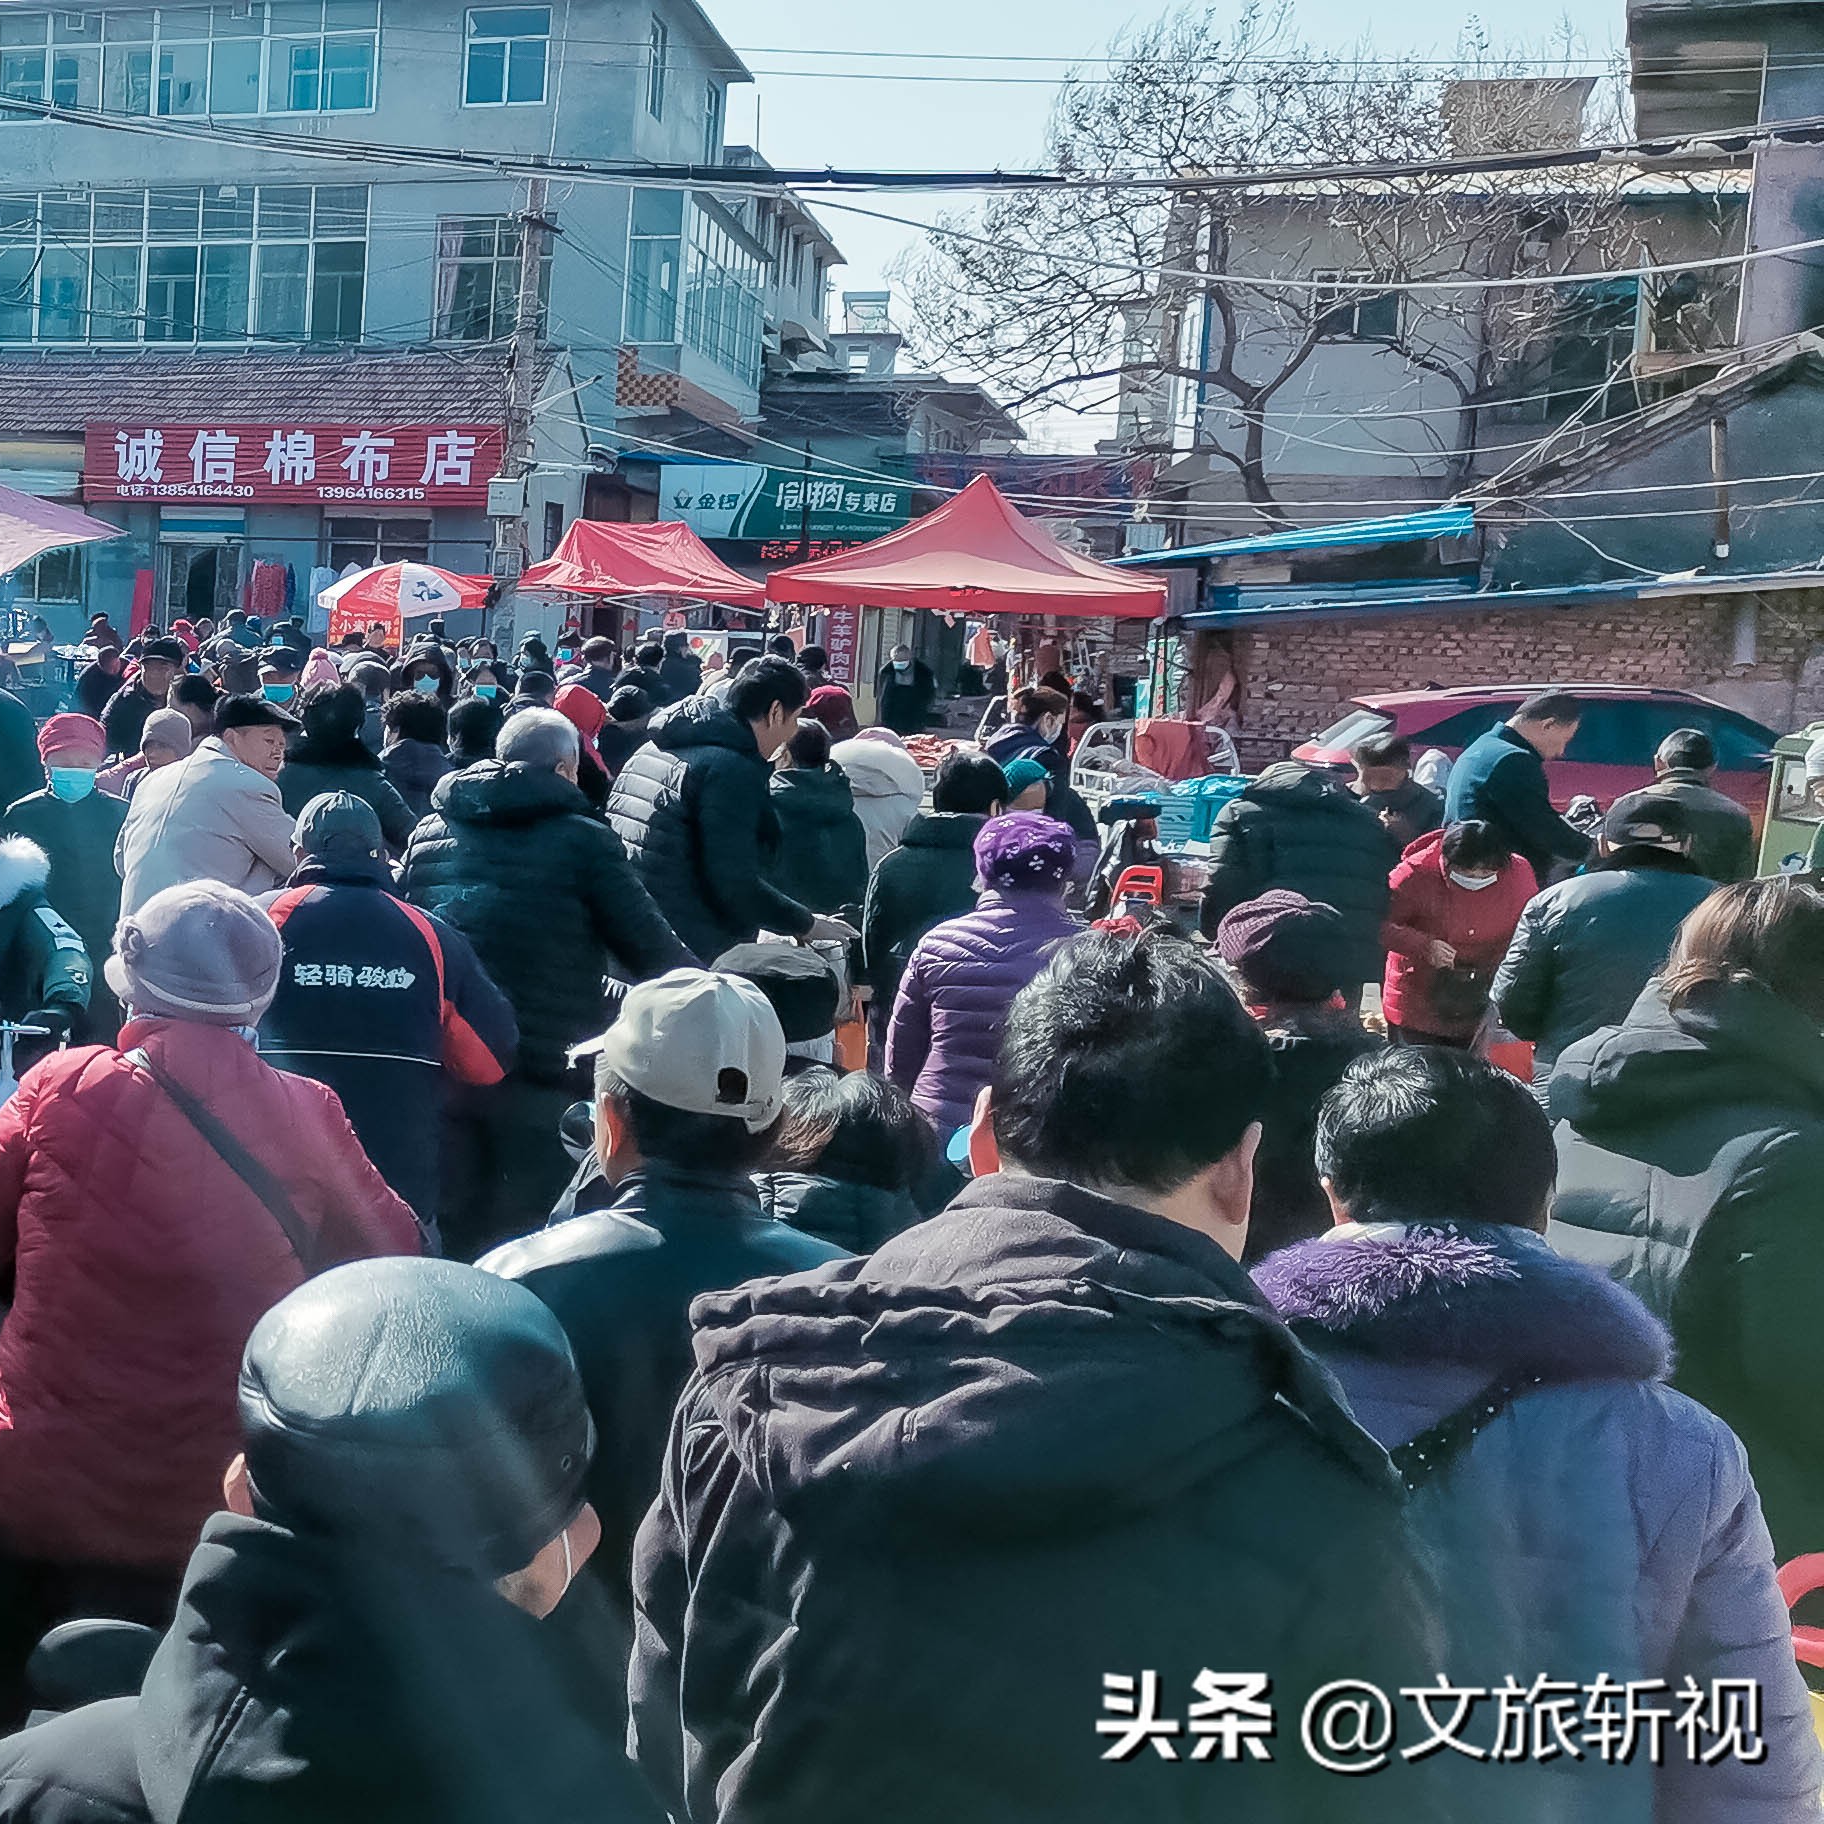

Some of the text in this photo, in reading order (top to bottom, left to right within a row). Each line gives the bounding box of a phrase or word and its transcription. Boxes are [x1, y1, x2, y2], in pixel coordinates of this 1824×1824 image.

[114, 429, 476, 487] 诚信棉布店
[316, 486, 425, 499] 13964166315
